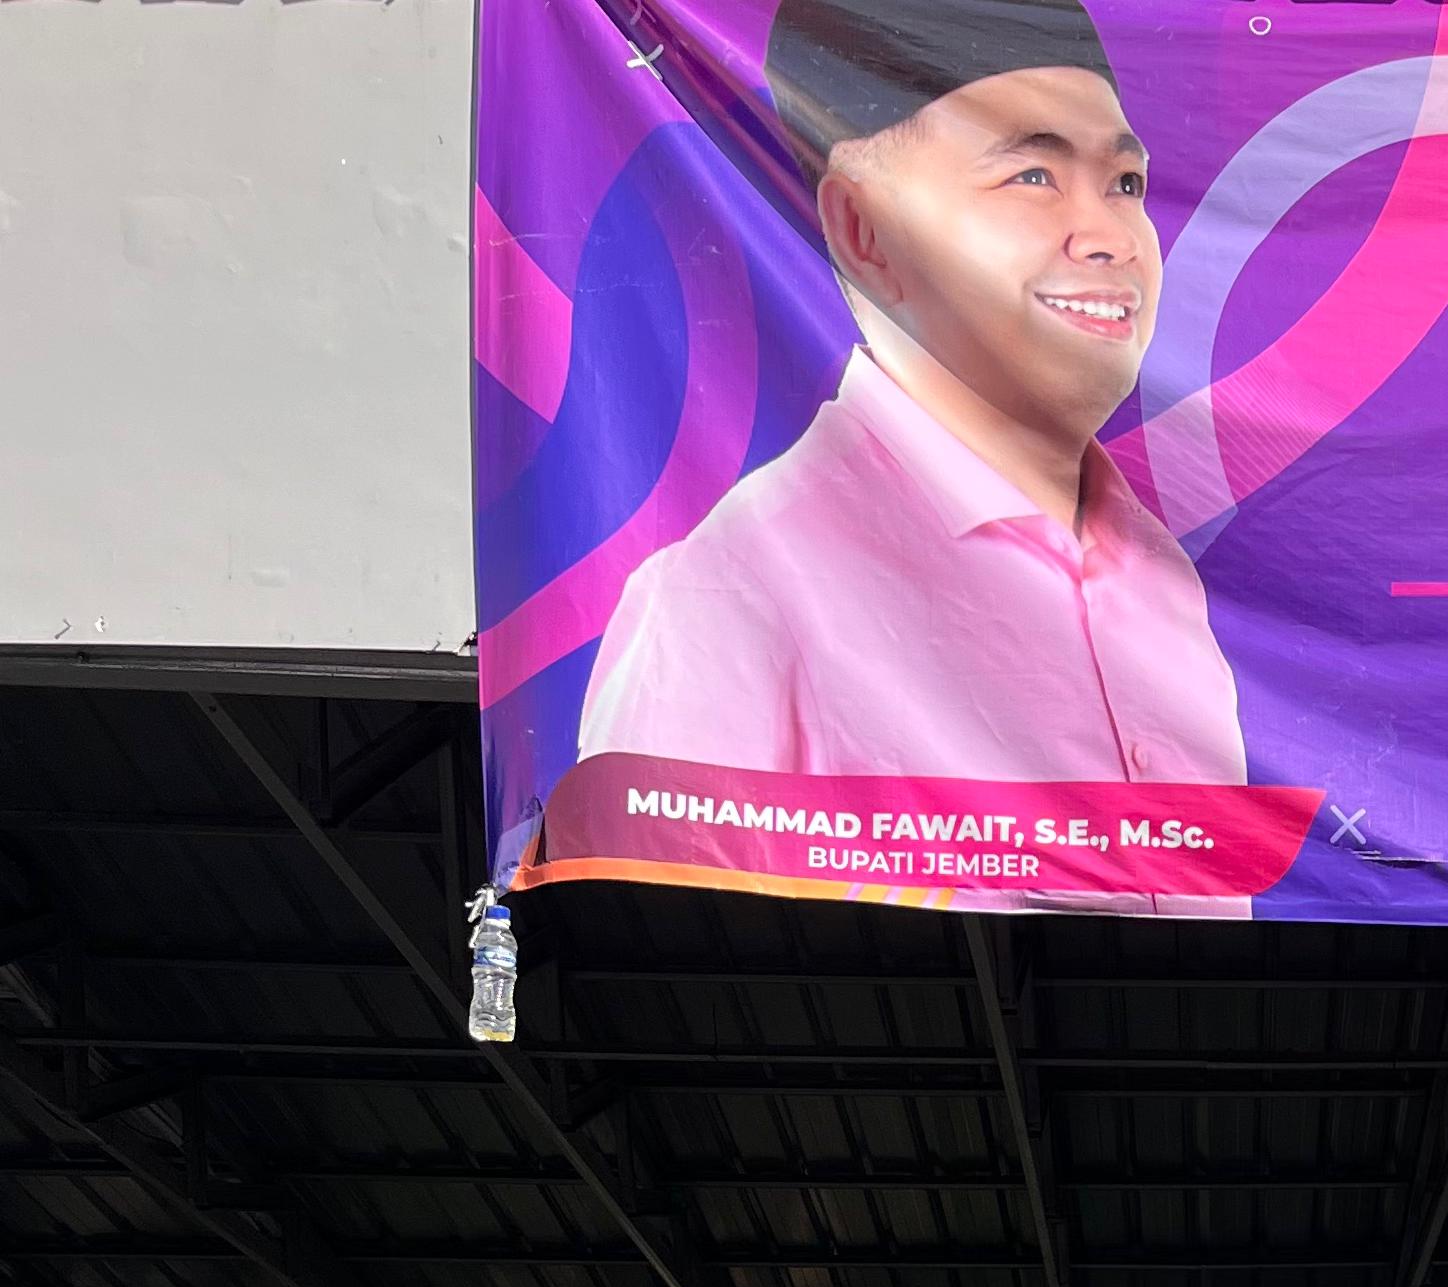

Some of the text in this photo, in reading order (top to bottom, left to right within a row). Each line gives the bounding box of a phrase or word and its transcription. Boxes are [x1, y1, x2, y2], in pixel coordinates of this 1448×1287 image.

[627, 787, 1215, 853] MUHAMMAD FAWAIT, S.E., M.Sc.
[807, 845, 1039, 878] BUPATI JEMBER
